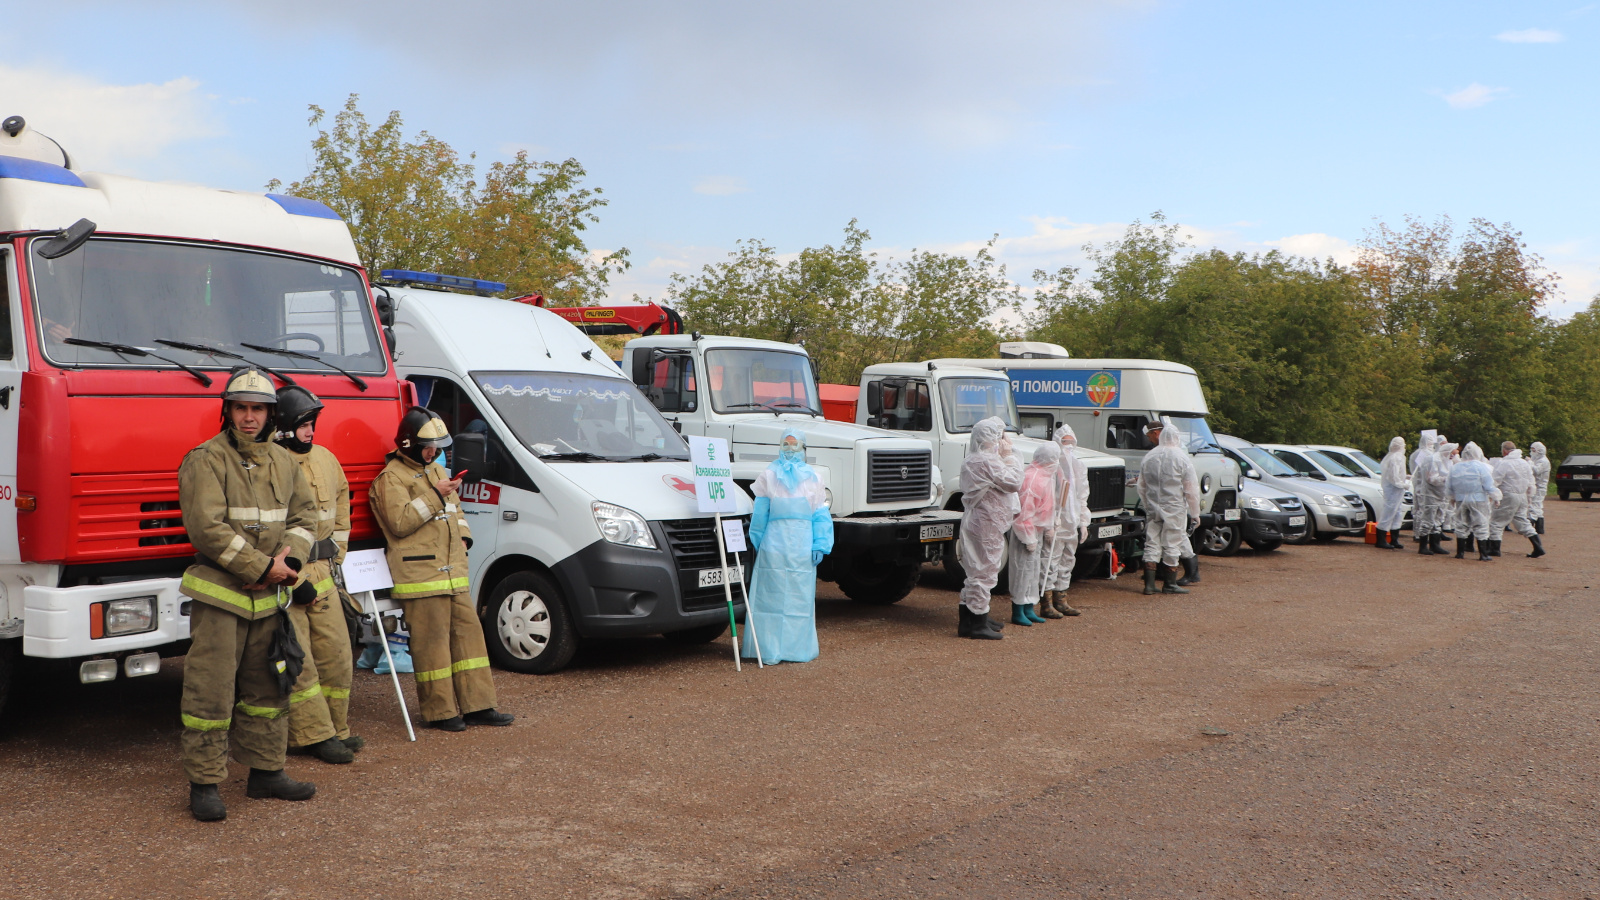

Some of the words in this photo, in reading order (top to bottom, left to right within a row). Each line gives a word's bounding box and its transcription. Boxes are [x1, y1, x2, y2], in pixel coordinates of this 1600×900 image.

[1023, 380, 1084, 396] ПОМОЩЬ
[695, 465, 731, 477] Азнакаевская
[707, 482, 726, 503] ЦРБ
